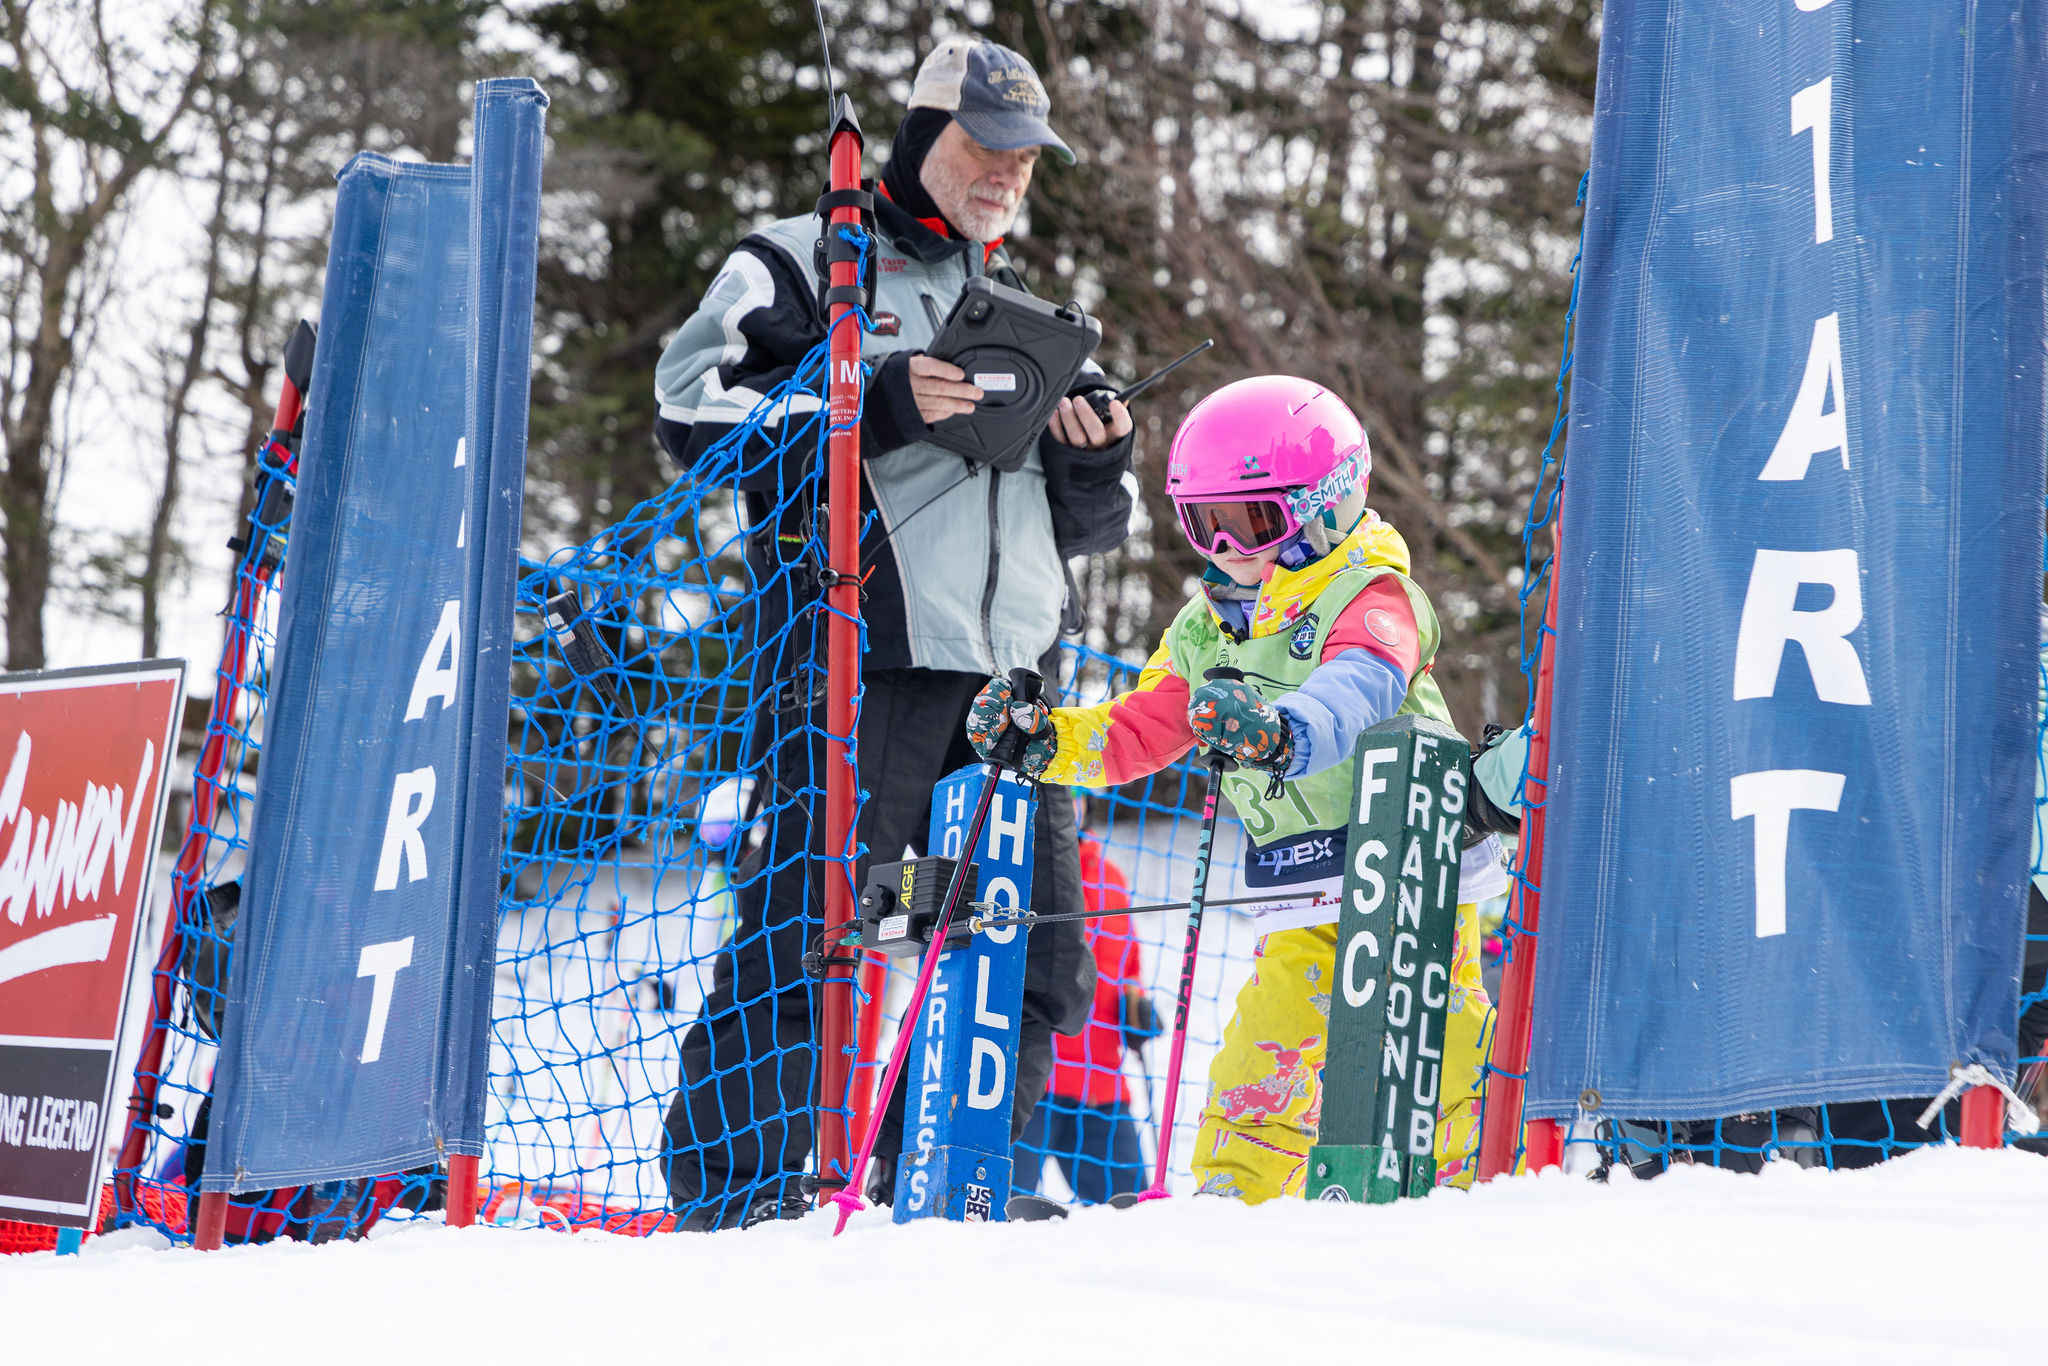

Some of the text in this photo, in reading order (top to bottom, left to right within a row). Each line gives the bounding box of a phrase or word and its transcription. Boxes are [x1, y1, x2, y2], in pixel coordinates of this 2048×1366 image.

[1309, 469, 1351, 508] SMITH
[1730, 0, 1873, 938] TART
[356, 437, 466, 1064] ART
[900, 864, 915, 910] ALGE
[1342, 747, 1398, 1008] FSC
[908, 781, 967, 1212] HOERNESS
[967, 792, 1029, 1111] HOLD
[1377, 734, 1439, 1183] FRANCONIA
[1408, 769, 1467, 1156] SKI CLUB
[25, 1095, 99, 1152] LEGEND
[967, 1184, 991, 1205] US
